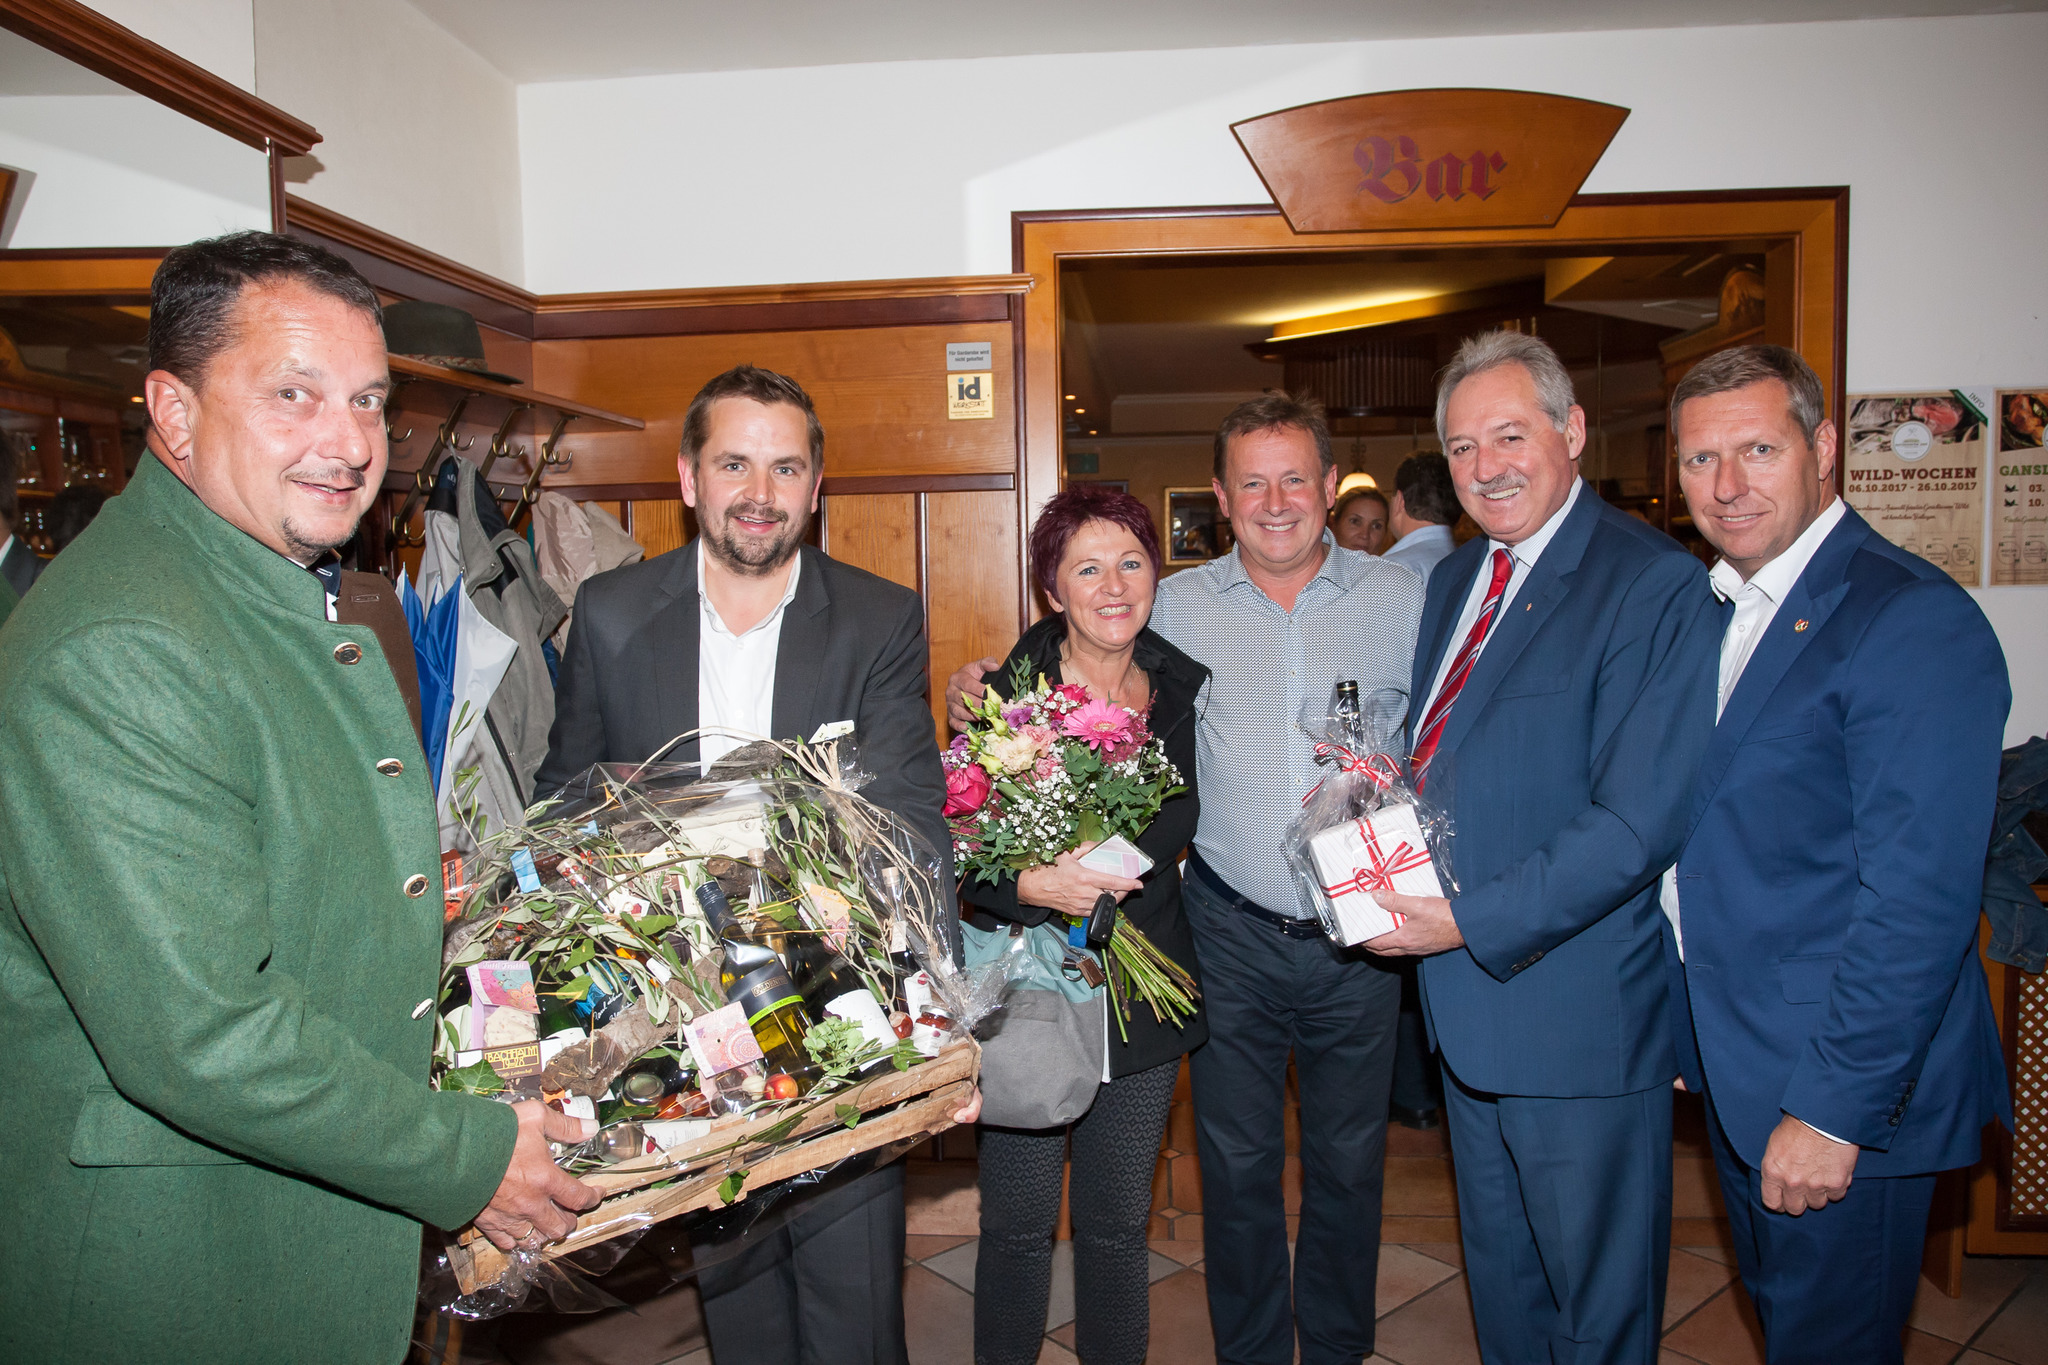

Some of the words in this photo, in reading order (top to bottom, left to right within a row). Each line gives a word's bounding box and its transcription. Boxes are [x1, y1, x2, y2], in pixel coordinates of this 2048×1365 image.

[1353, 134, 1508, 204] Bar
[958, 376, 981, 400] id
[1968, 392, 1985, 409] INFO
[1849, 467, 1977, 481] WILD-WOCHEN
[1848, 483, 1907, 493] 06.10.2017
[1917, 482, 1977, 492] 26.10.2017
[2028, 484, 2046, 493] 03.
[2028, 498, 2045, 507] 10.
